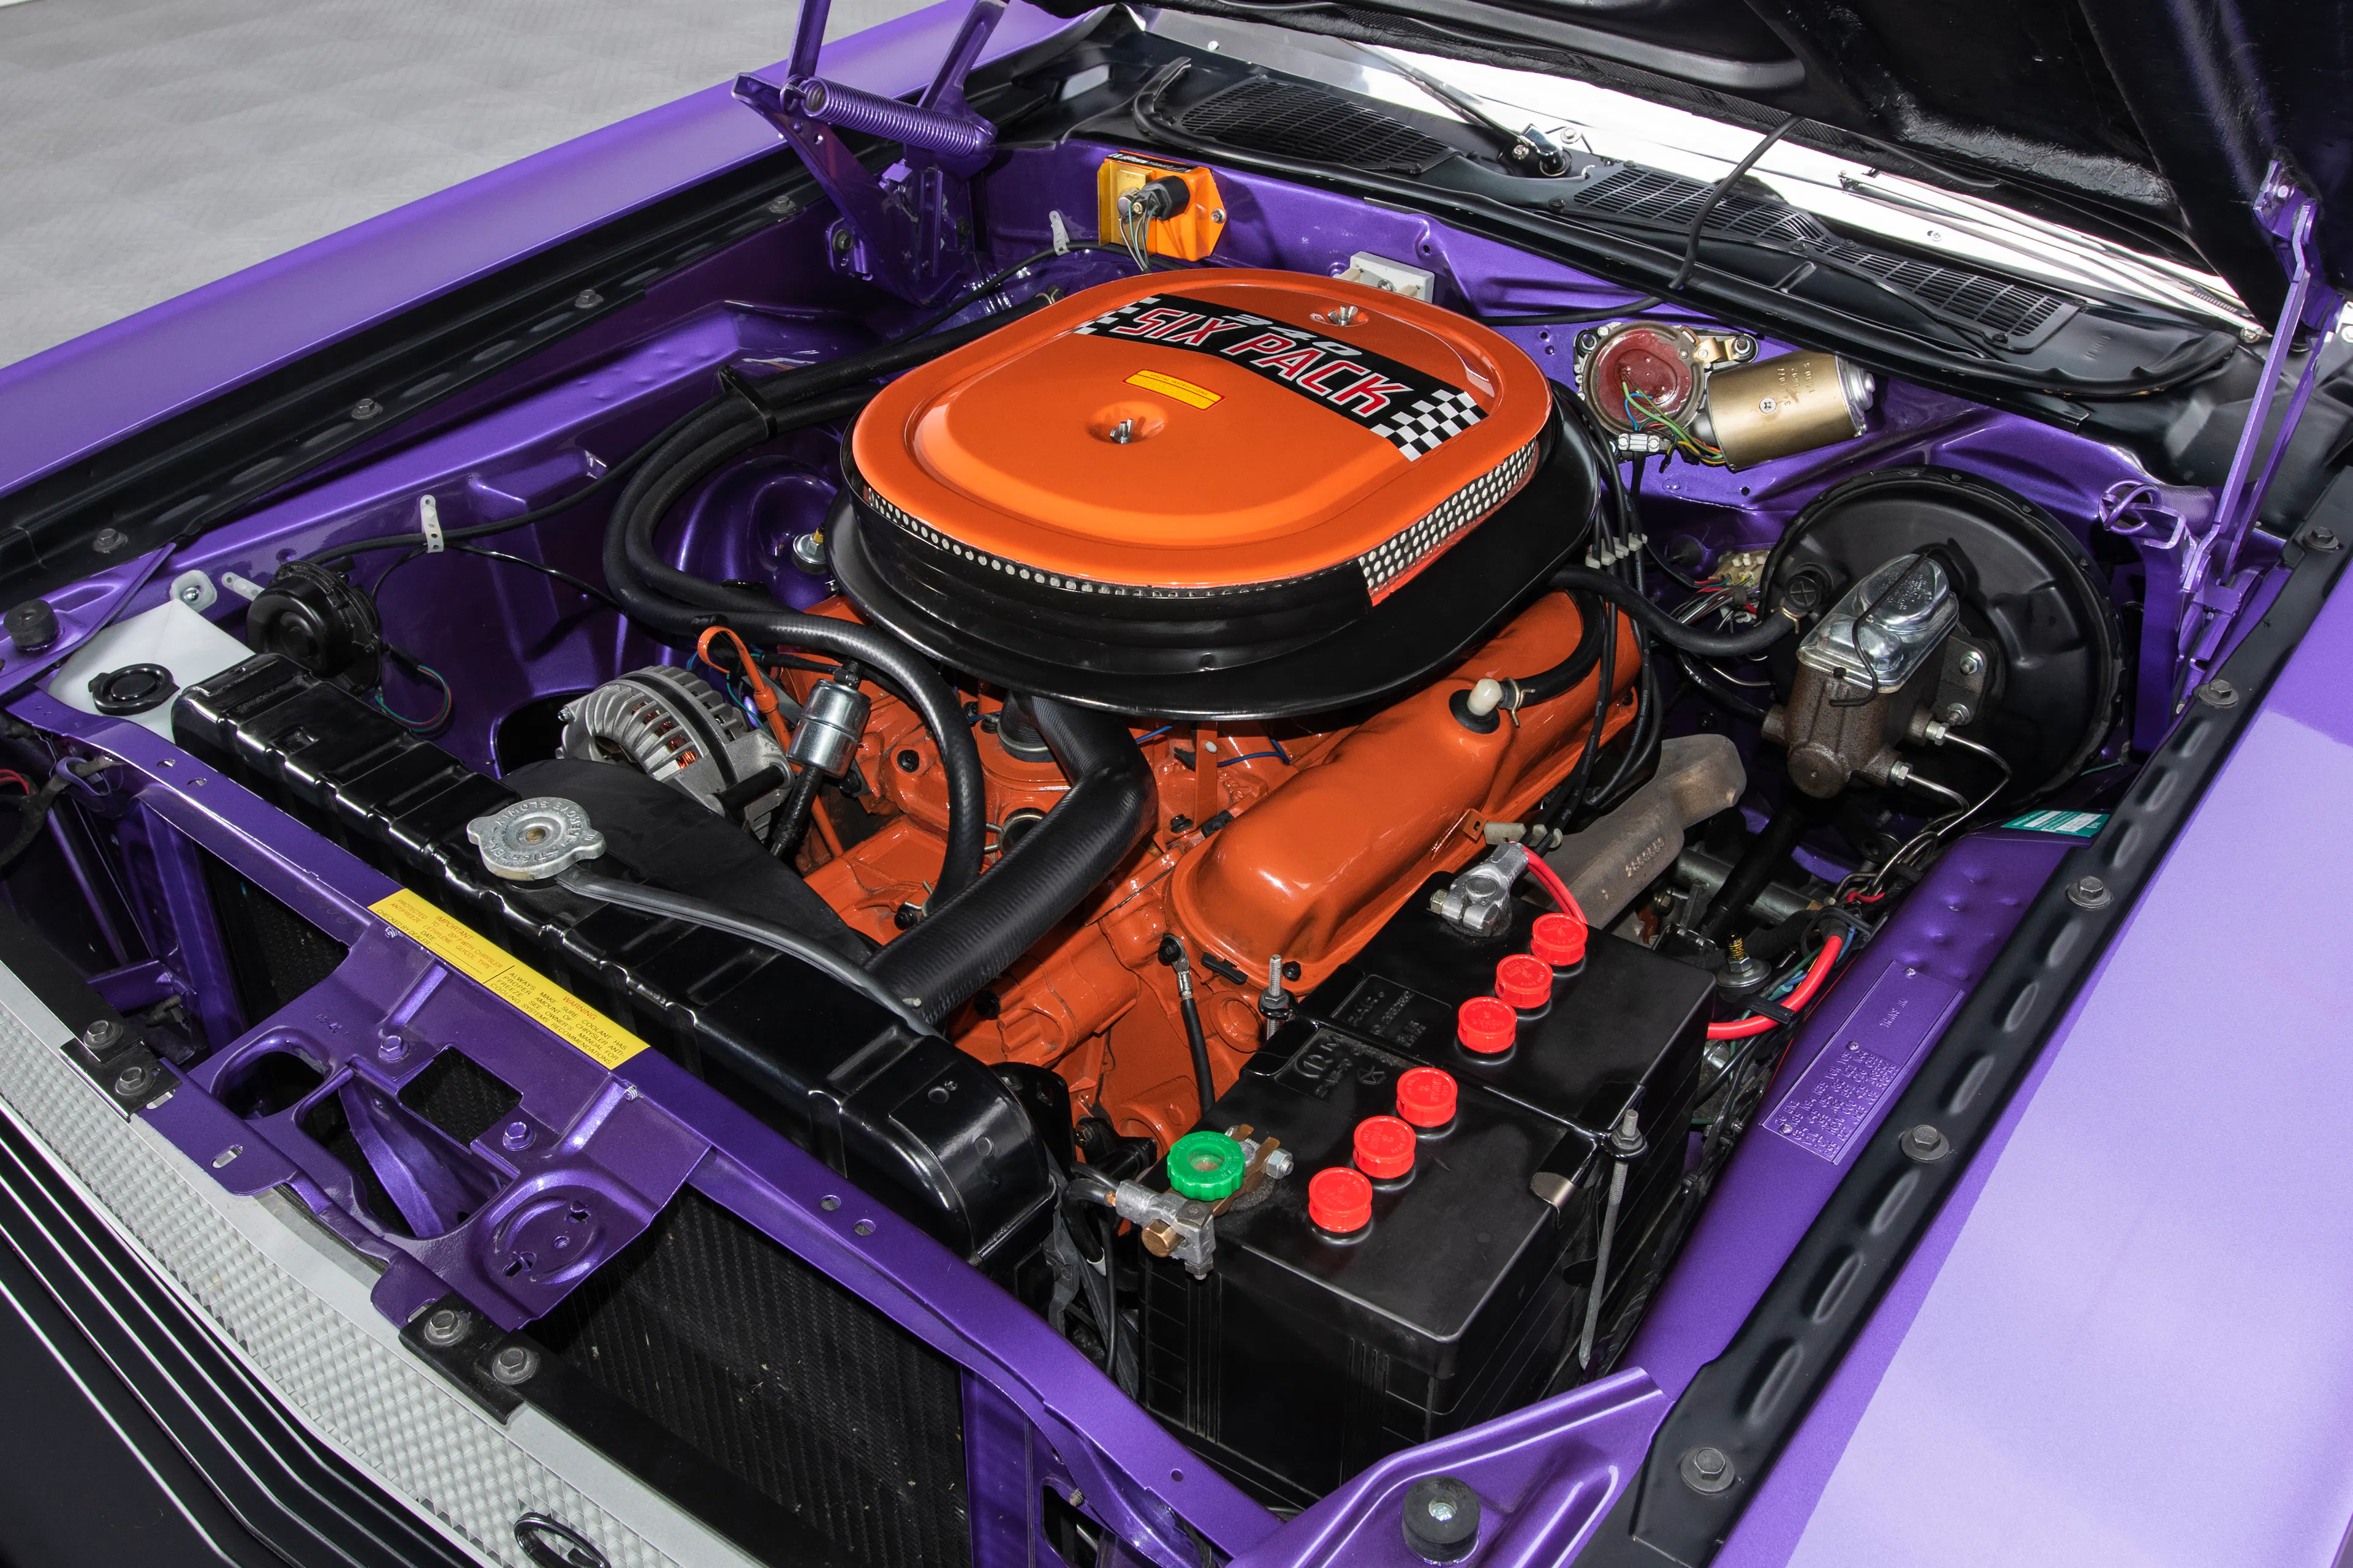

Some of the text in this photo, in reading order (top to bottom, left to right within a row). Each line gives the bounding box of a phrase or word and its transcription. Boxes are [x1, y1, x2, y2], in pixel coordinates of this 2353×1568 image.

[1222, 313, 1363, 357] 340
[1110, 308, 1247, 347] SIX
[1222, 333, 1414, 418] PACK
[1170, 380, 1208, 396] INSTRUCTIONS
[494, 801, 549, 827] SLOWLY
[376, 909, 403, 926] CHECKED
[434, 915, 474, 941] IMPORTANT
[389, 902, 422, 923] ANTIFREEZE
[454, 945, 477, 960] GLYCOL
[396, 899, 428, 919] PROTECTED
[473, 949, 503, 968] CHRYSLER
[419, 930, 436, 941] DATE
[489, 982, 521, 1004] COOLING
[520, 1003, 550, 1023] SYSTEMS
[508, 972, 628, 1050] ALWAYS MAKE SURE COOLANT HAS
[561, 996, 598, 1020] WARNING
[502, 975, 532, 995] PROPER
[533, 996, 561, 1014] AMOUNT
[574, 1023, 608, 1045] CHRYSLER
[607, 1044, 626, 1057] ANTI-
[1880, 1009, 1900, 1028] TRANS
[528, 1000, 543, 1010] SEE
[544, 1010, 574, 1031] OWNER'S
[577, 1032, 604, 1050] MANUAL
[603, 1050, 619, 1060] FOR
[1801, 1097, 1816, 1110] N94
[1817, 1094, 1832, 1107] J54
